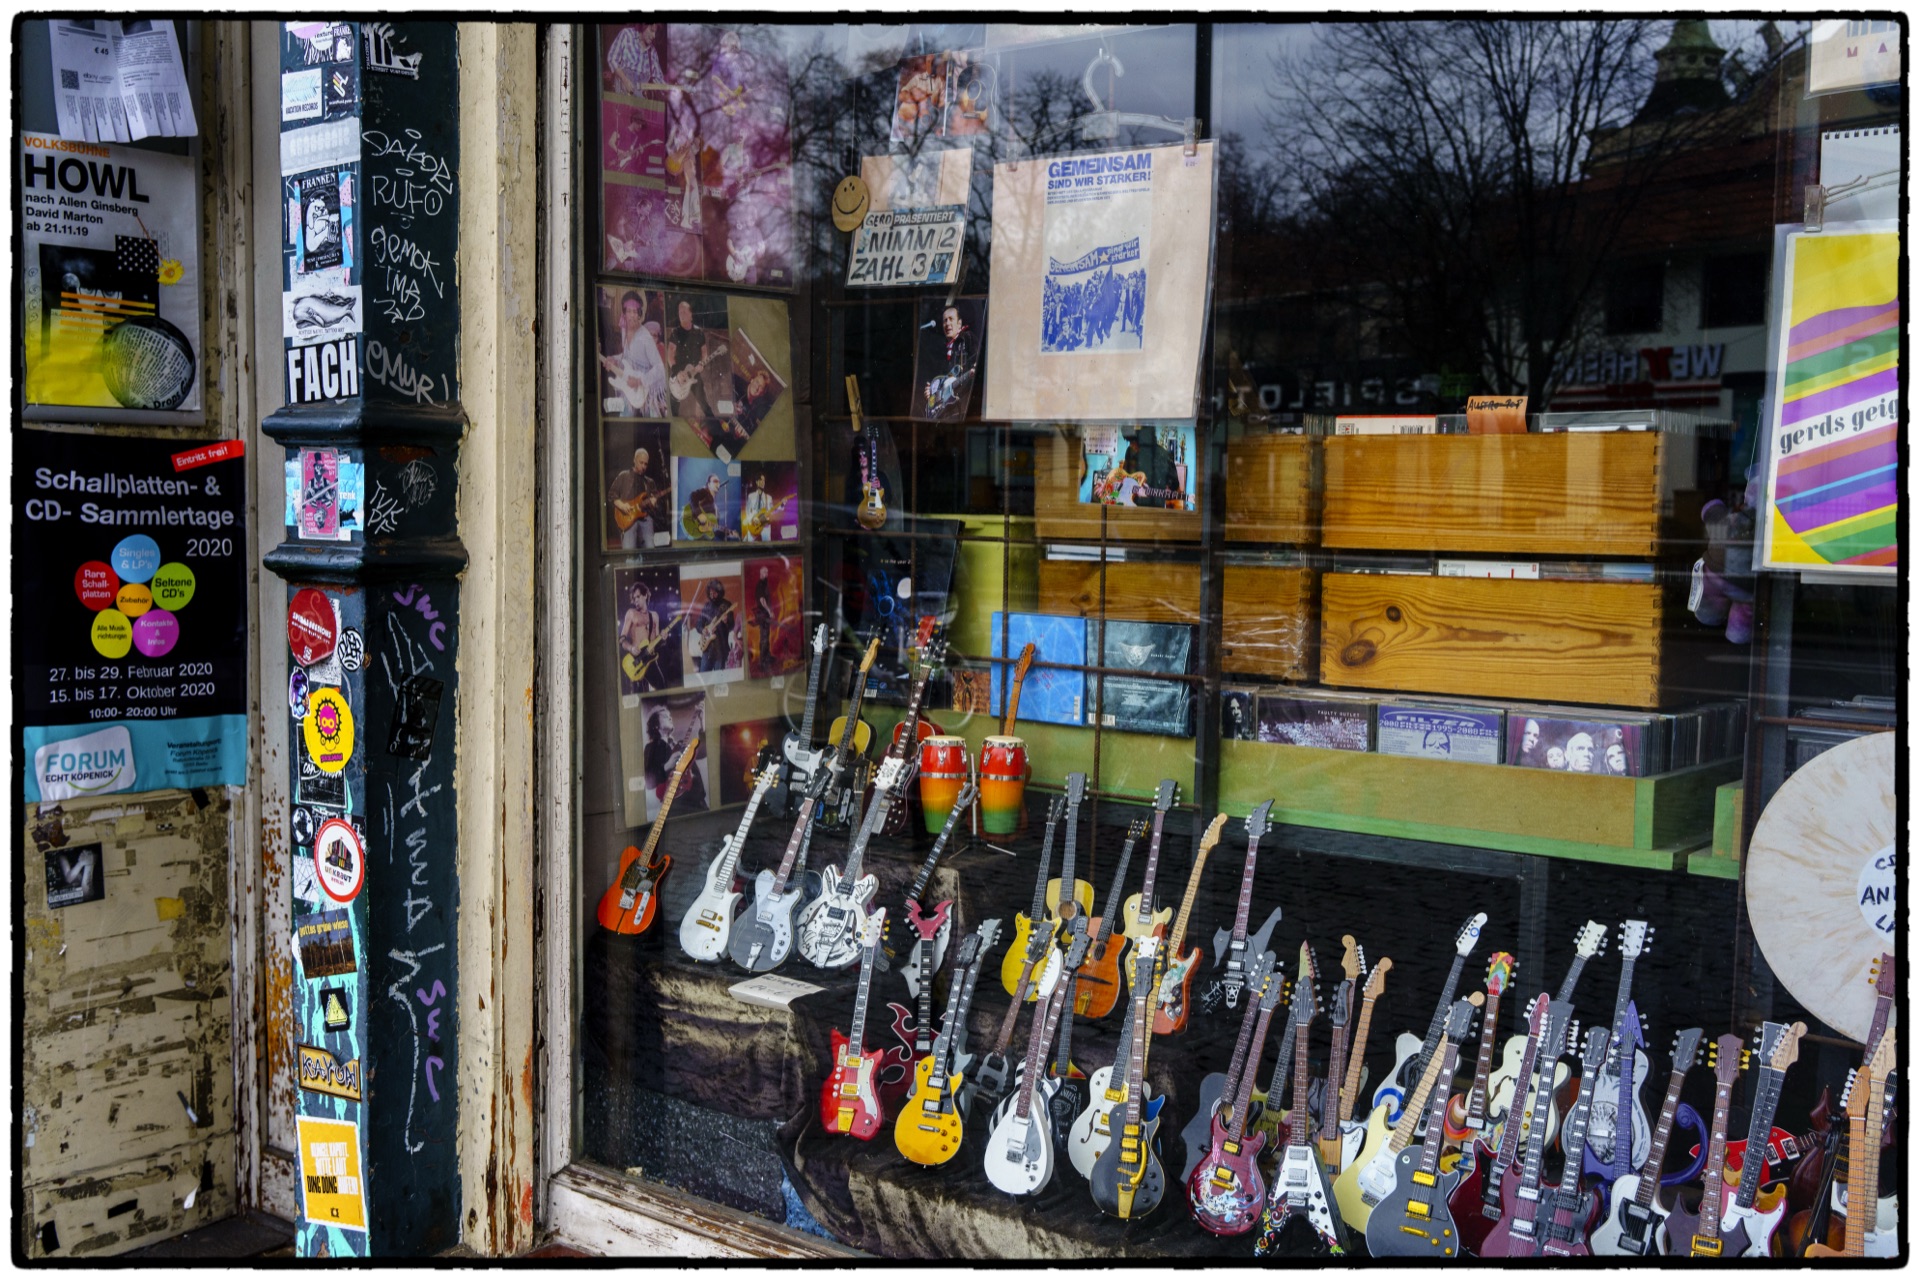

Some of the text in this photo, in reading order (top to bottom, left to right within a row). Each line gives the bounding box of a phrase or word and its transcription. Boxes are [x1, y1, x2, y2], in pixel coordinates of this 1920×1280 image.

[24, 136, 111, 158] VOLKSBÜHNE
[1048, 152, 1152, 178] GEMEINSAM
[24, 153, 150, 204] HOWL
[302, 172, 336, 189] FRANKEN
[1047, 178, 1072, 190] SIND
[1075, 176, 1095, 187] WIR
[25, 193, 139, 217] nach Allen Ginsberg
[26, 206, 104, 225] David Marton
[865, 213, 892, 227] GERD
[26, 222, 89, 236] ab 21.11.19
[868, 226, 957, 253] NIMM 2
[850, 252, 927, 282] ZAHL 3
[1050, 252, 1099, 273] GEMEINSAM
[288, 339, 358, 404] FACH
[153, 393, 180, 410] Drops
[1780, 415, 1845, 454] gerds
[176, 446, 229, 468] Eintritt frei!
[35, 467, 221, 498] Schallplatten- &
[25, 499, 234, 530] CD- Sammlertage
[119, 548, 156, 561] Singles
[186, 538, 233, 557] 2020
[121, 559, 153, 570] & LP's
[84, 569, 106, 579] Rare
[82, 579, 110, 588] Schall-
[155, 578, 192, 588] Seltene
[82, 589, 111, 600] platten
[120, 596, 149, 605] Zubehör
[162, 588, 185, 599] CD's
[141, 619, 174, 628] Kontakte
[50, 662, 213, 682] 27. bis 29. Februar 2020
[50, 682, 215, 703] 15. bis 17. Oktober 2020
[89, 706, 178, 719] 10:00- 20:00 Uhr
[1396, 715, 1476, 727] FILTER
[46, 748, 126, 773] FORUM
[45, 769, 114, 783] ECHT KÖPENICK
[299, 923, 316, 937] gottes
[307, 1176, 322, 1194] DING
